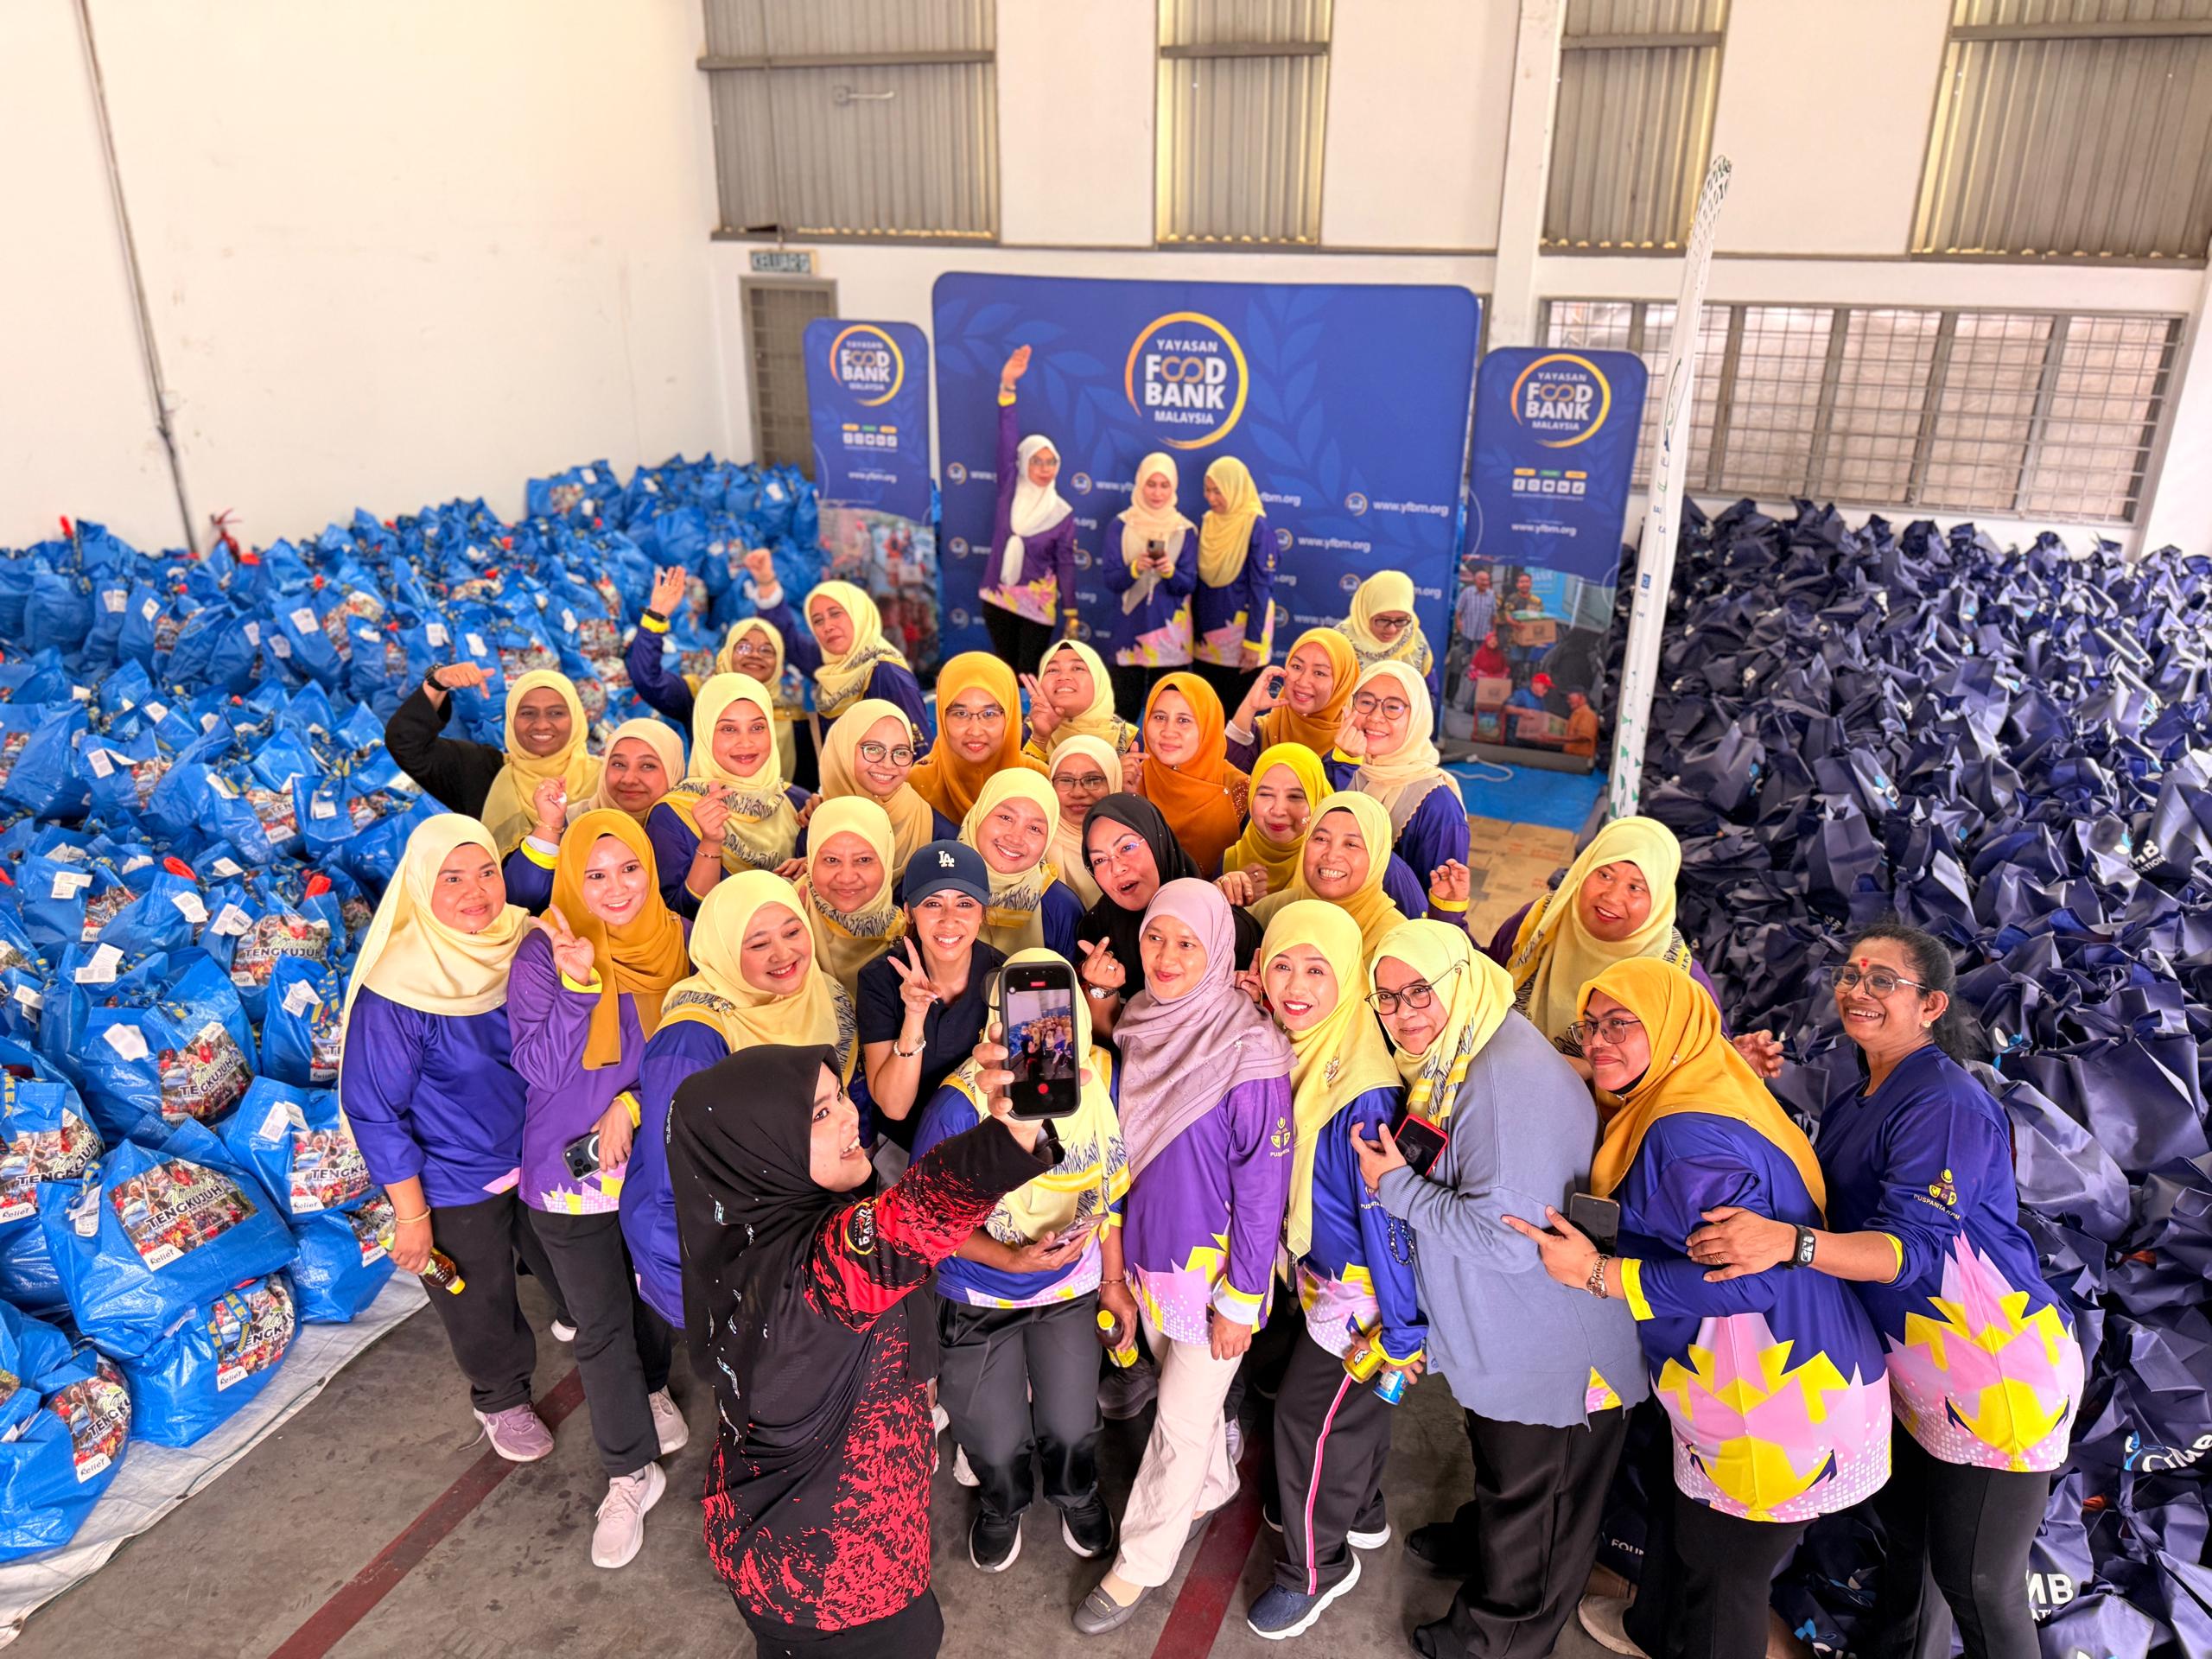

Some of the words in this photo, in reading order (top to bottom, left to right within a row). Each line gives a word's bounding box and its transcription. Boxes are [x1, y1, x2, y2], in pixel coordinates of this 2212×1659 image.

[1156, 339, 1218, 353] YAYASAN
[841, 349, 891, 365] FOOD
[842, 365, 891, 383] BANK
[1146, 354, 1227, 385] FOOD
[1537, 372, 1587, 382] YAYASAN
[1145, 382, 1226, 410] BANK
[1527, 382, 1593, 403] FOOD
[1154, 410, 1215, 424] MALAYSIA
[1525, 400, 1591, 421] BANK
[1532, 420, 1580, 431] MALAYSIA
[1259, 492, 1301, 508] fbm.org
[1373, 501, 1449, 518] www.yfbm.org
[1511, 522, 1577, 537] www.yfbm.org
[1298, 536, 1371, 554] www.yfbm.org
[938, 850, 955, 868] LA
[179, 1058, 234, 1096] TEGKUJUH
[311, 1163, 367, 1179] TENGKU
[145, 1185, 223, 1230] TENGKUJUH
[1913, 1193, 1946, 1212] PUSPANITA
[2025, 1569, 2074, 1605] MB
